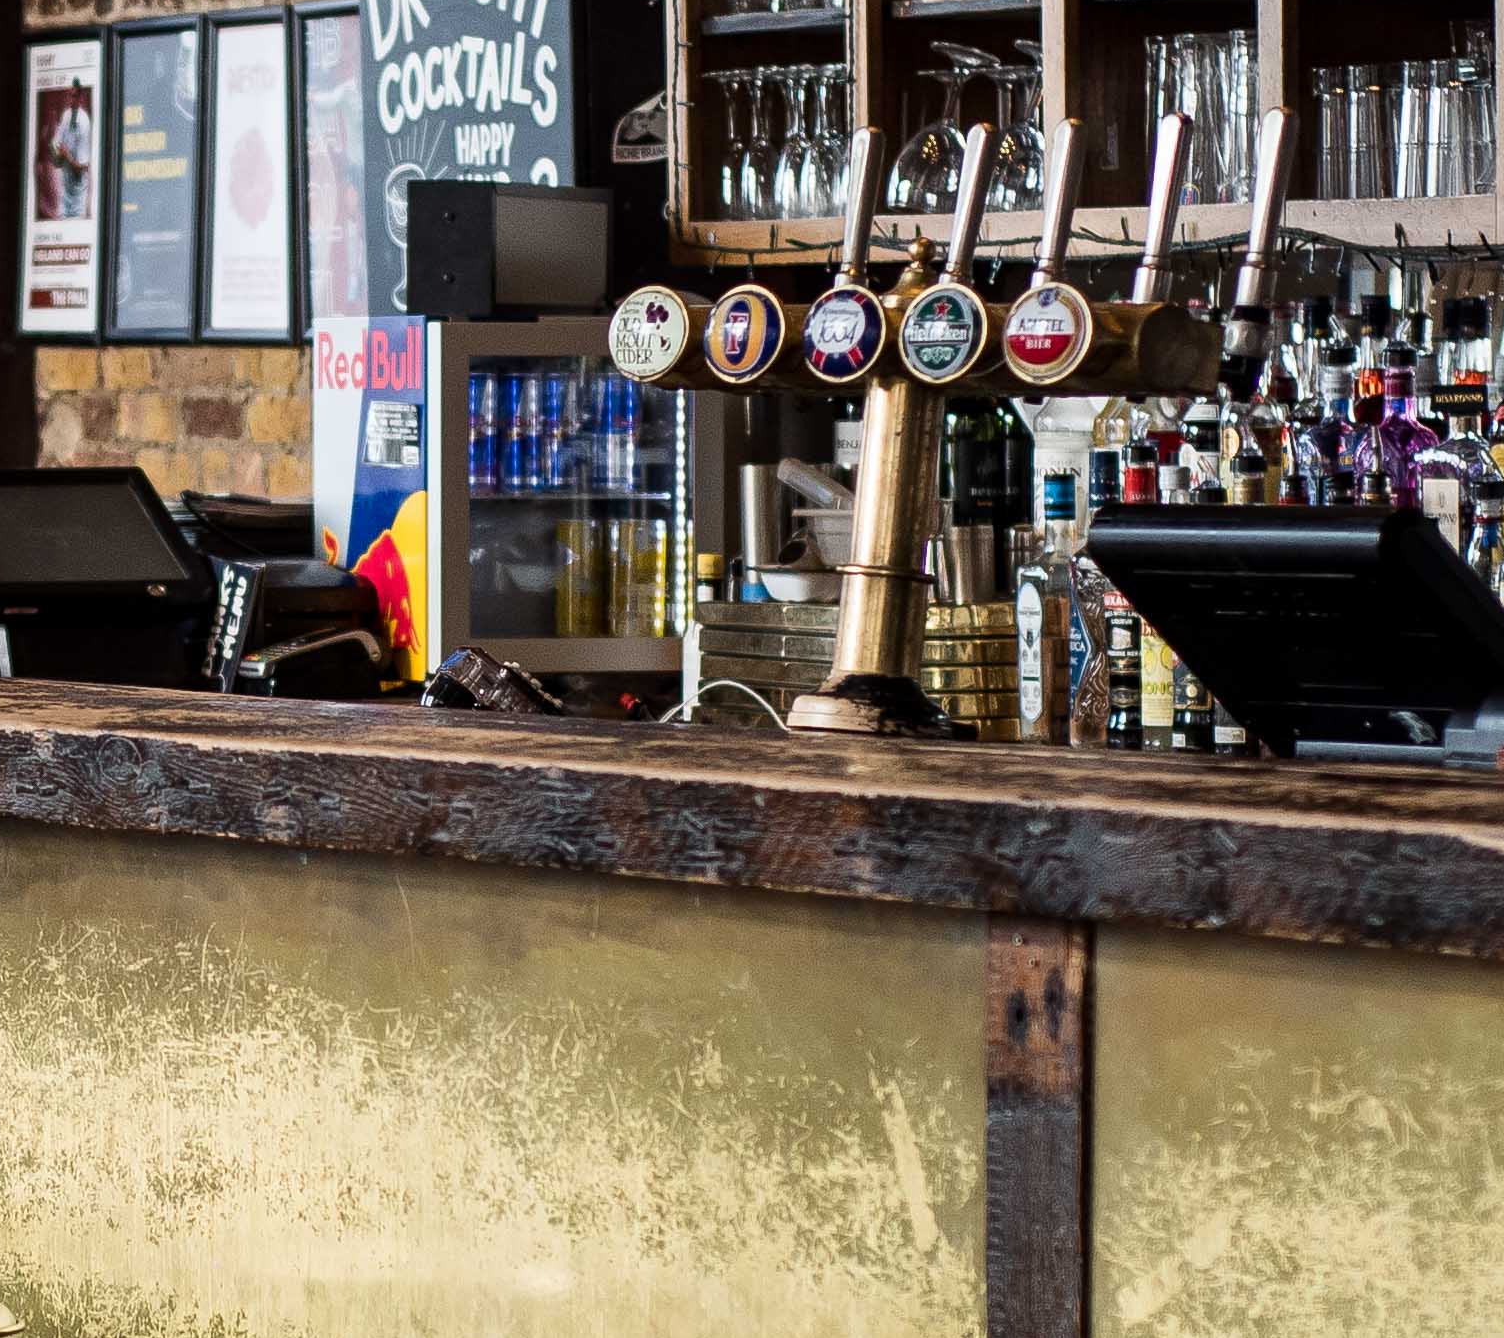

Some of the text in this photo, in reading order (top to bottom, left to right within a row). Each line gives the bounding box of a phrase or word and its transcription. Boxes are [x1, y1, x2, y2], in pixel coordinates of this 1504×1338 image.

[377, 31, 559, 135] COCKTAILS
[455, 121, 515, 166] HAPPY
[910, 323, 969, 341] Heineken
[1024, 337, 1053, 350] BIER
[318, 325, 423, 391] Red Bull
[616, 349, 654, 364] CIDER
[1435, 393, 1484, 404] DISARONNO
